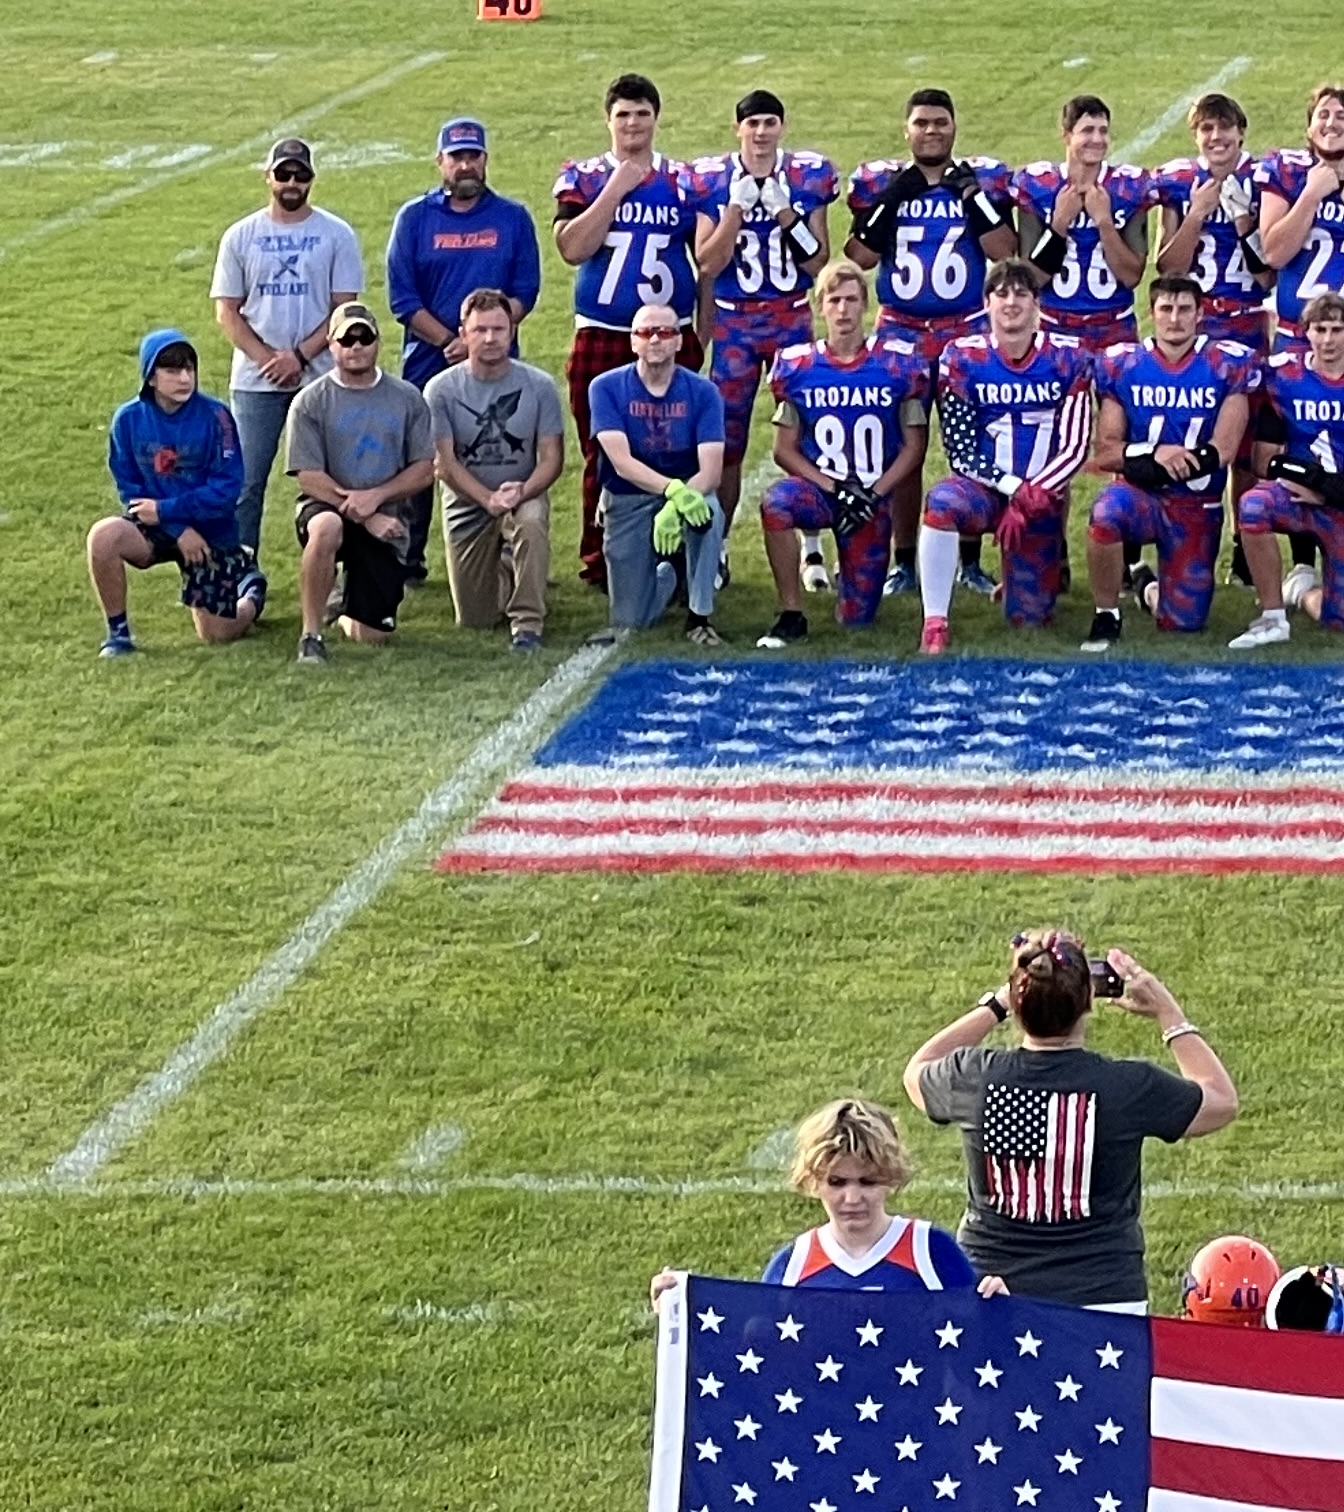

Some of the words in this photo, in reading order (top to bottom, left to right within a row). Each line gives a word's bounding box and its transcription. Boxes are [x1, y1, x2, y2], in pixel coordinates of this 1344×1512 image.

[611, 202, 680, 227] ROJANS
[896, 199, 964, 219] ROJAN
[597, 232, 675, 306] 75
[735, 225, 798, 293] 30
[891, 226, 969, 300] 56
[801, 387, 893, 408] TROJANS
[975, 381, 1062, 404] TROJANS
[1131, 386, 1216, 409] TROJANS
[814, 414, 884, 488] 80
[986, 410, 1058, 488] 17
[1230, 1286, 1260, 1308] 40
